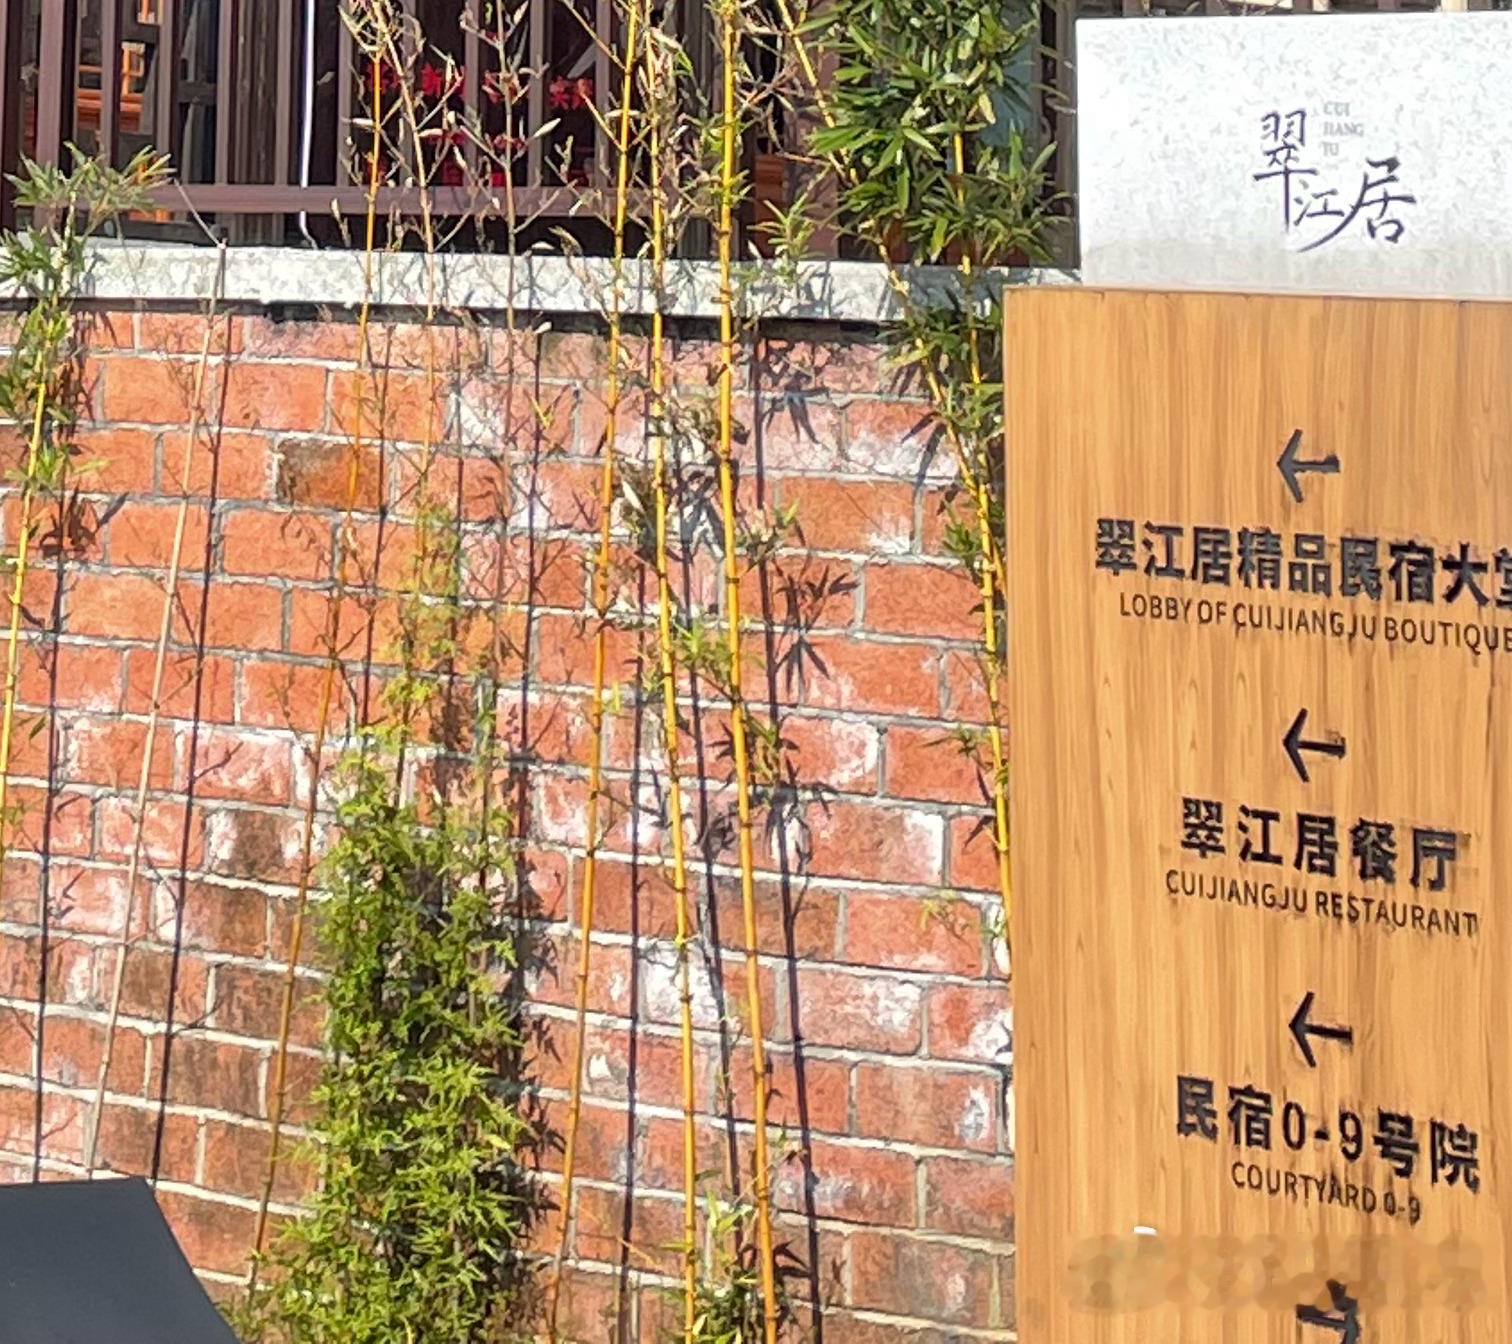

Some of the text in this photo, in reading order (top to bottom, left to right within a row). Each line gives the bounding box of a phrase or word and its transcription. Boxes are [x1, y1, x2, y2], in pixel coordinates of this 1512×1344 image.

[1253, 108, 1418, 252] 翠江居
[1119, 592, 1512, 655] LOBBY OF CUIJIANGJU BOUTIQUE
[1180, 796, 1458, 892] 翠江居餐厅
[1165, 869, 1479, 937] CUIJIANGJU RESTAURANT
[1177, 1075, 1480, 1194] 民宿0-9号院
[1231, 1162, 1421, 1227] COURTYARD 0-9
